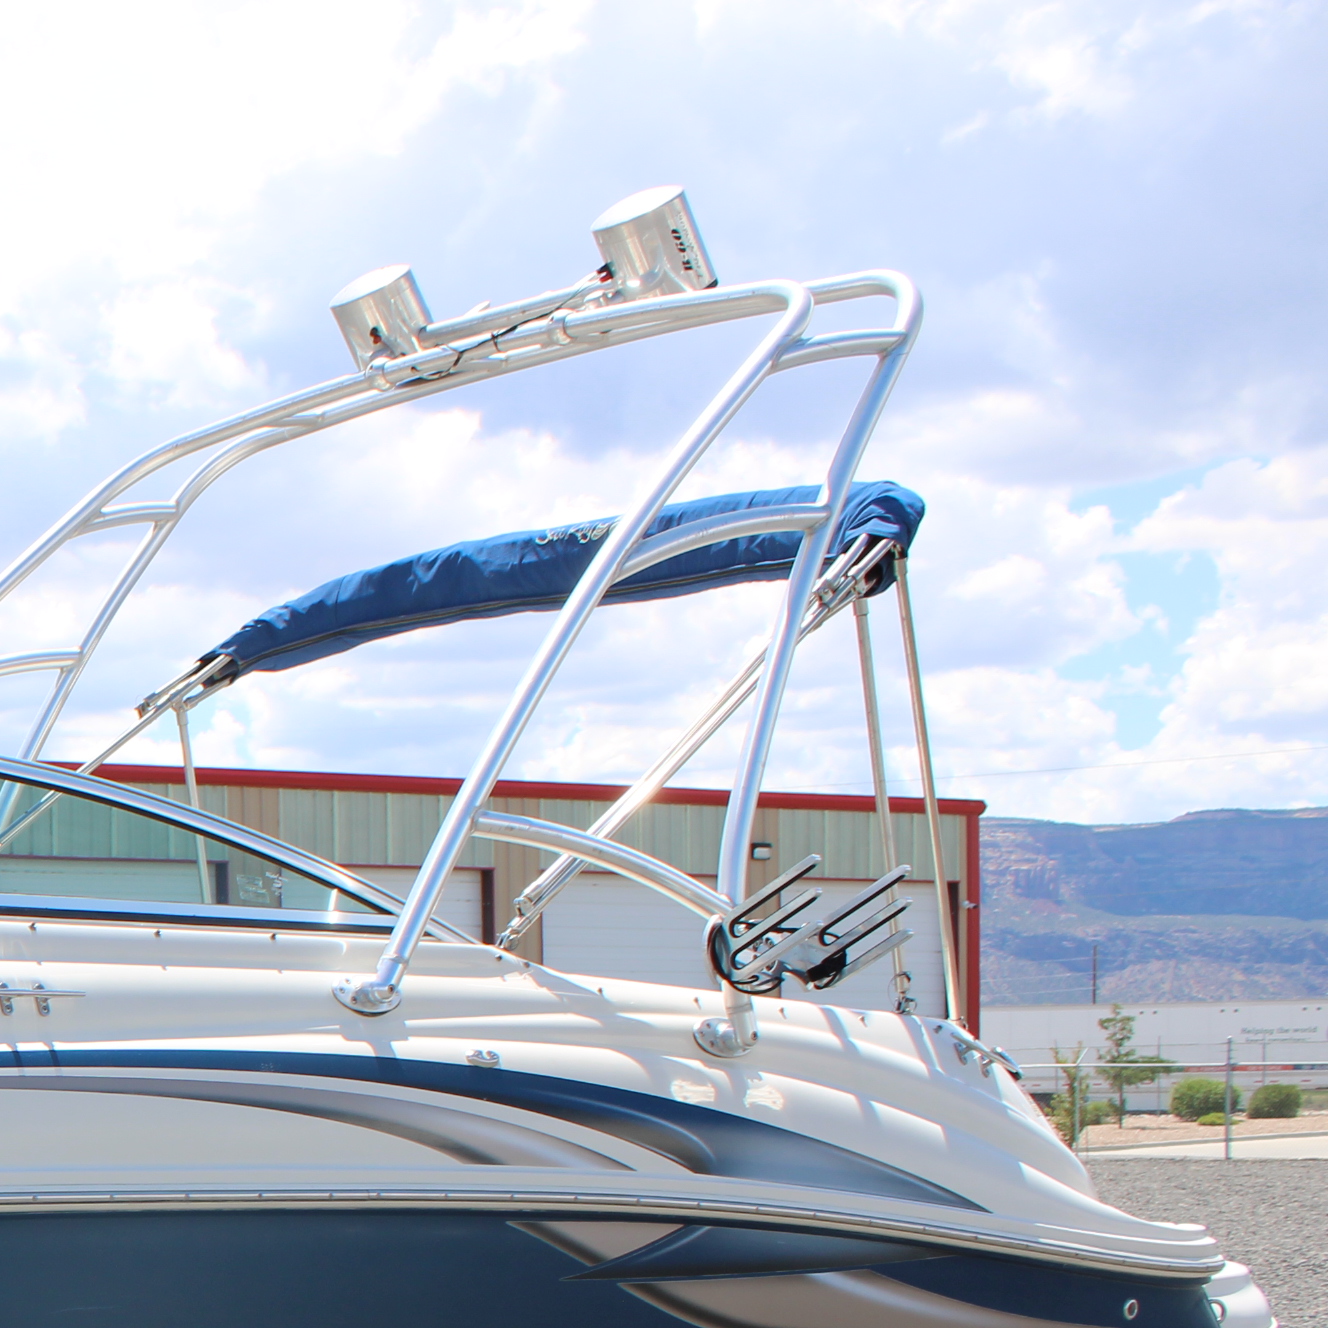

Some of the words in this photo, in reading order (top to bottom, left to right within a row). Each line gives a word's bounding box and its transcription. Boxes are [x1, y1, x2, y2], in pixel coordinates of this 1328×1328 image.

[1241, 1027, 1275, 1036] Helping
[1276, 1026, 1290, 1034] the
[1292, 1026, 1318, 1034] world
